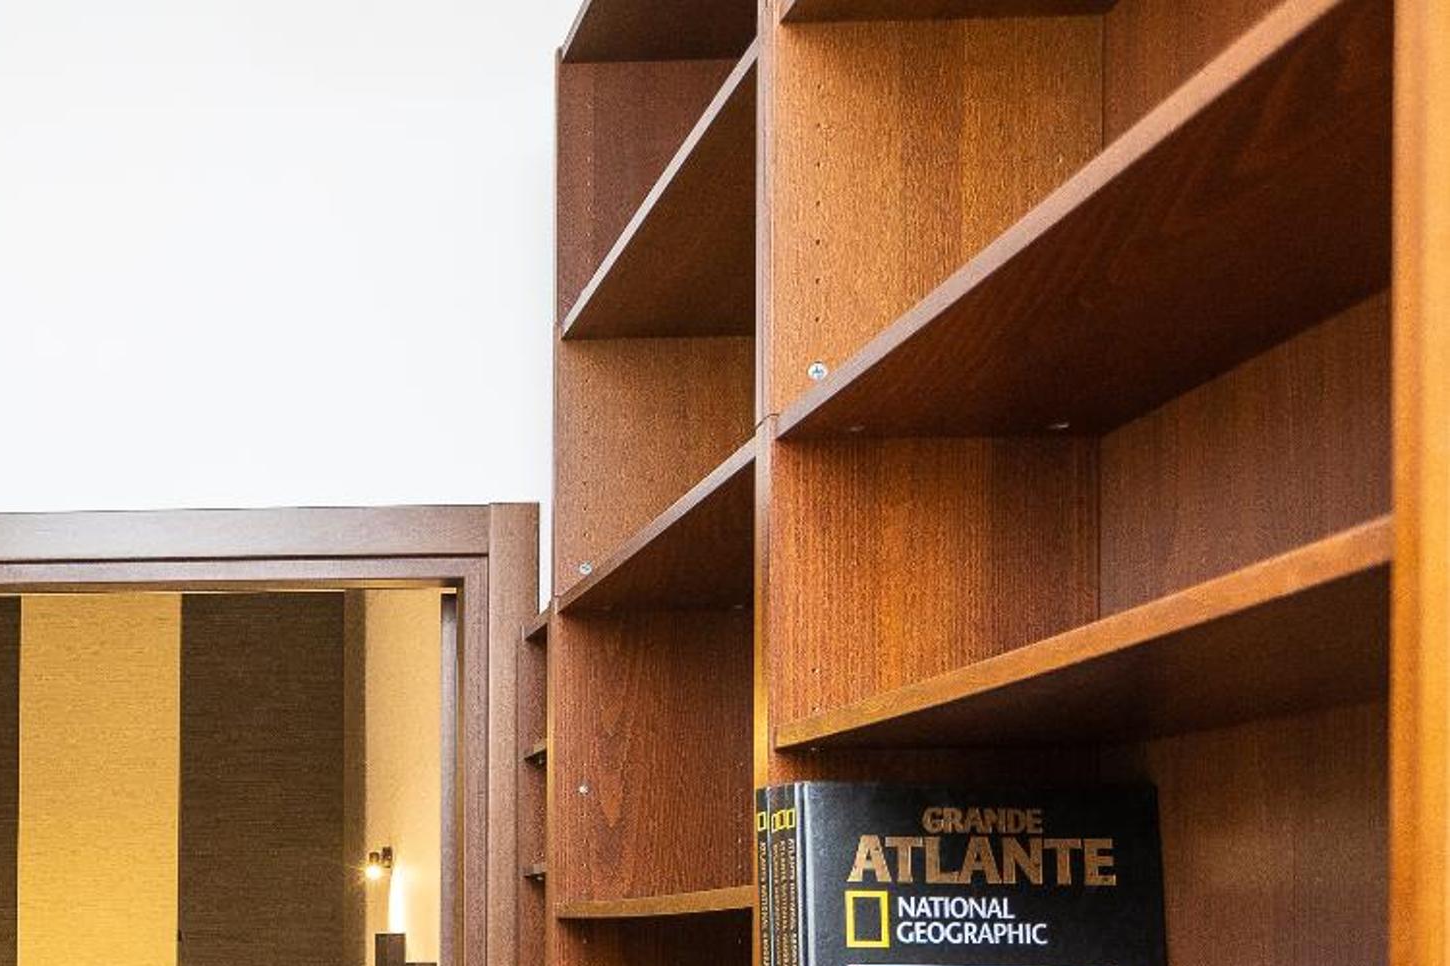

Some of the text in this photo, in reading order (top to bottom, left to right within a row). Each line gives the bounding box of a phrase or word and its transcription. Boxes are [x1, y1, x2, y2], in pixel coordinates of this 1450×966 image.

[922, 807, 1044, 834] GRANDE
[846, 834, 1117, 887] ATLANTE
[897, 896, 1016, 920] NATIONAL
[896, 921, 1049, 945] GEOGRAPHIC
